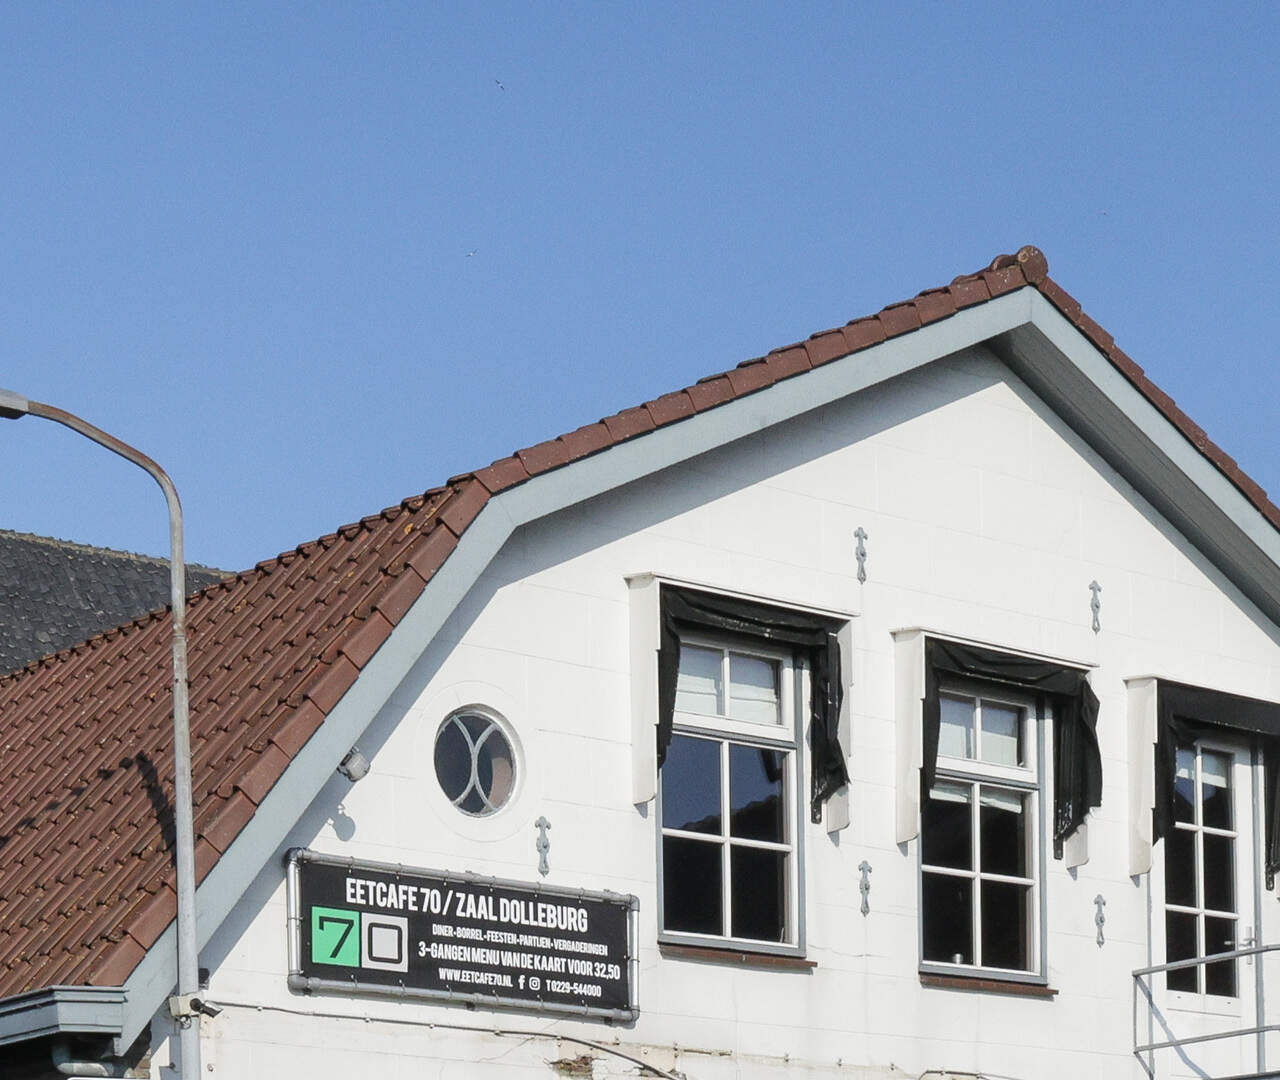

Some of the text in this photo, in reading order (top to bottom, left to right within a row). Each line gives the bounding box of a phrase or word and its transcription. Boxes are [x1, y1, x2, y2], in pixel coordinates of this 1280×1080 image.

[346, 877, 418, 912] EETCAFE
[420, 887, 441, 914] 70
[455, 892, 498, 921] ZAAL
[499, 897, 588, 933] DOLLEBURG
[418, 941, 471, 963] 3-GANGEN
[471, 947, 500, 965] MENU
[500, 950, 521, 968] VAN
[533, 954, 567, 973] KAART
[567, 958, 594, 977] VOOR
[594, 962, 621, 980] 32,50
